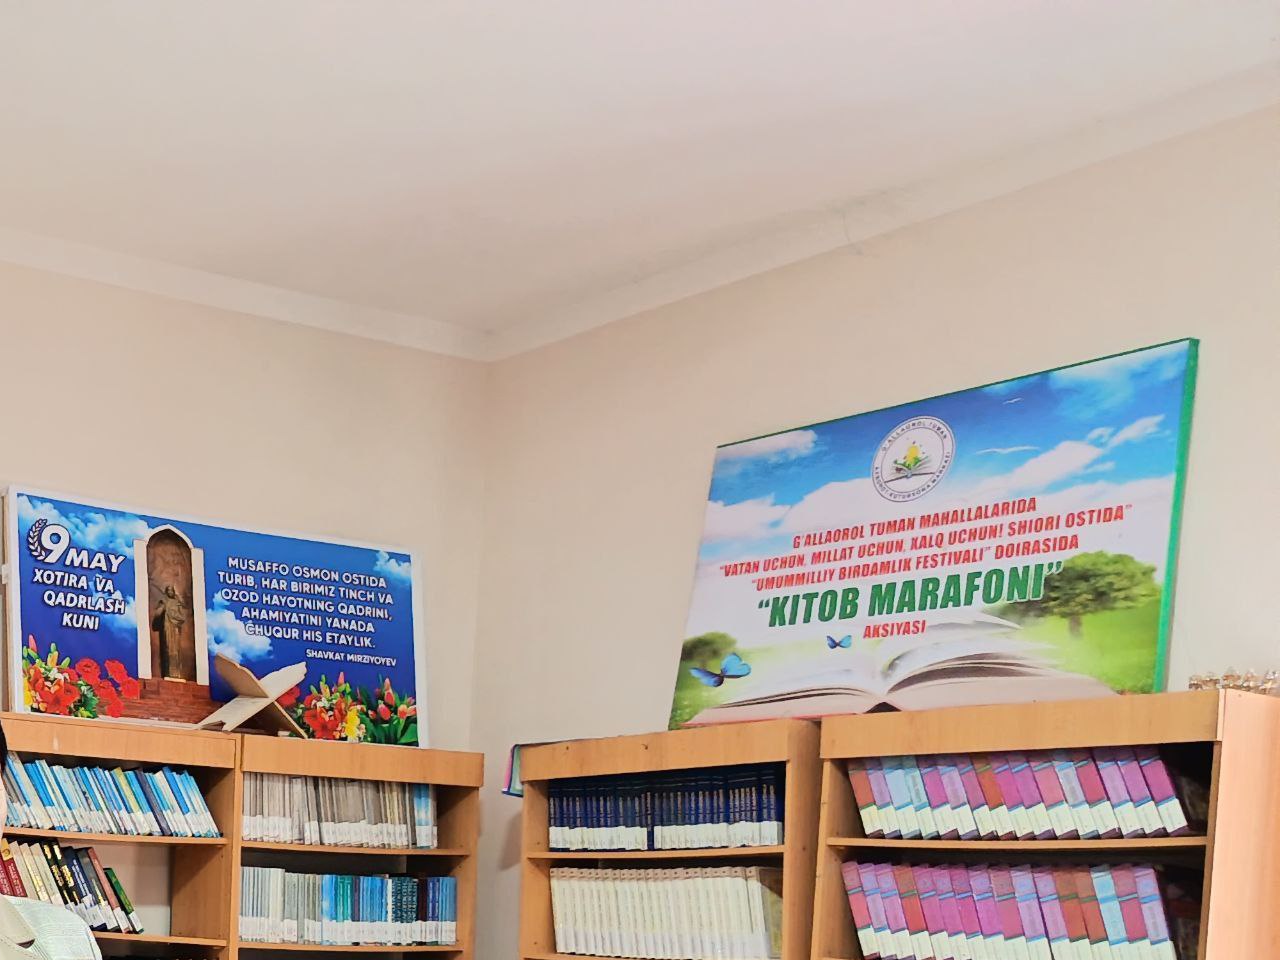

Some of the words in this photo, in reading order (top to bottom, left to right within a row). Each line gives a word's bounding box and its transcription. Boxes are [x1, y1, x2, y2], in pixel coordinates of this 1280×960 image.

[870, 517, 915, 537] TUMAN
[919, 497, 1037, 529] MAHALLALARIDA
[41, 523, 71, 564] 9
[64, 547, 126, 573] MAY
[811, 547, 854, 565] MILLAT
[910, 533, 944, 551] XALQ
[948, 523, 1003, 546] UCHUN!
[1008, 515, 1061, 537] SHIORI
[839, 558, 912, 581] BIRDAMLIK
[995, 534, 1079, 560] DOIRASIDA
[33, 568, 88, 590] XOTIRA
[95, 576, 115, 594] VA
[228, 557, 290, 576] MUSAFFO
[292, 566, 339, 582] OSMON
[342, 572, 387, 589] OSTIDA
[43, 590, 126, 614] QADRLASH
[217, 571, 258, 590] TURIB,
[261, 577, 287, 591] HAR
[290, 581, 336, 597] BIRIMIZ
[338, 587, 375, 602] TINCH
[377, 593, 394, 605] VA
[221, 588, 259, 603] OZOD
[262, 594, 335, 613] HAYOTNING
[337, 603, 393, 621] QADRINI,
[62, 612, 100, 630] KUNI
[241, 607, 322, 627] AHAMIYATINI
[325, 617, 375, 633] YANADA
[863, 620, 926, 639] AKSIYASI
[245, 622, 300, 640] CHUQUR
[302, 630, 323, 643] HIS
[325, 632, 376, 648] ETAYLIK.
[306, 649, 345, 661] SHAVKAT
[346, 653, 397, 667] MIRZIYOYEV
